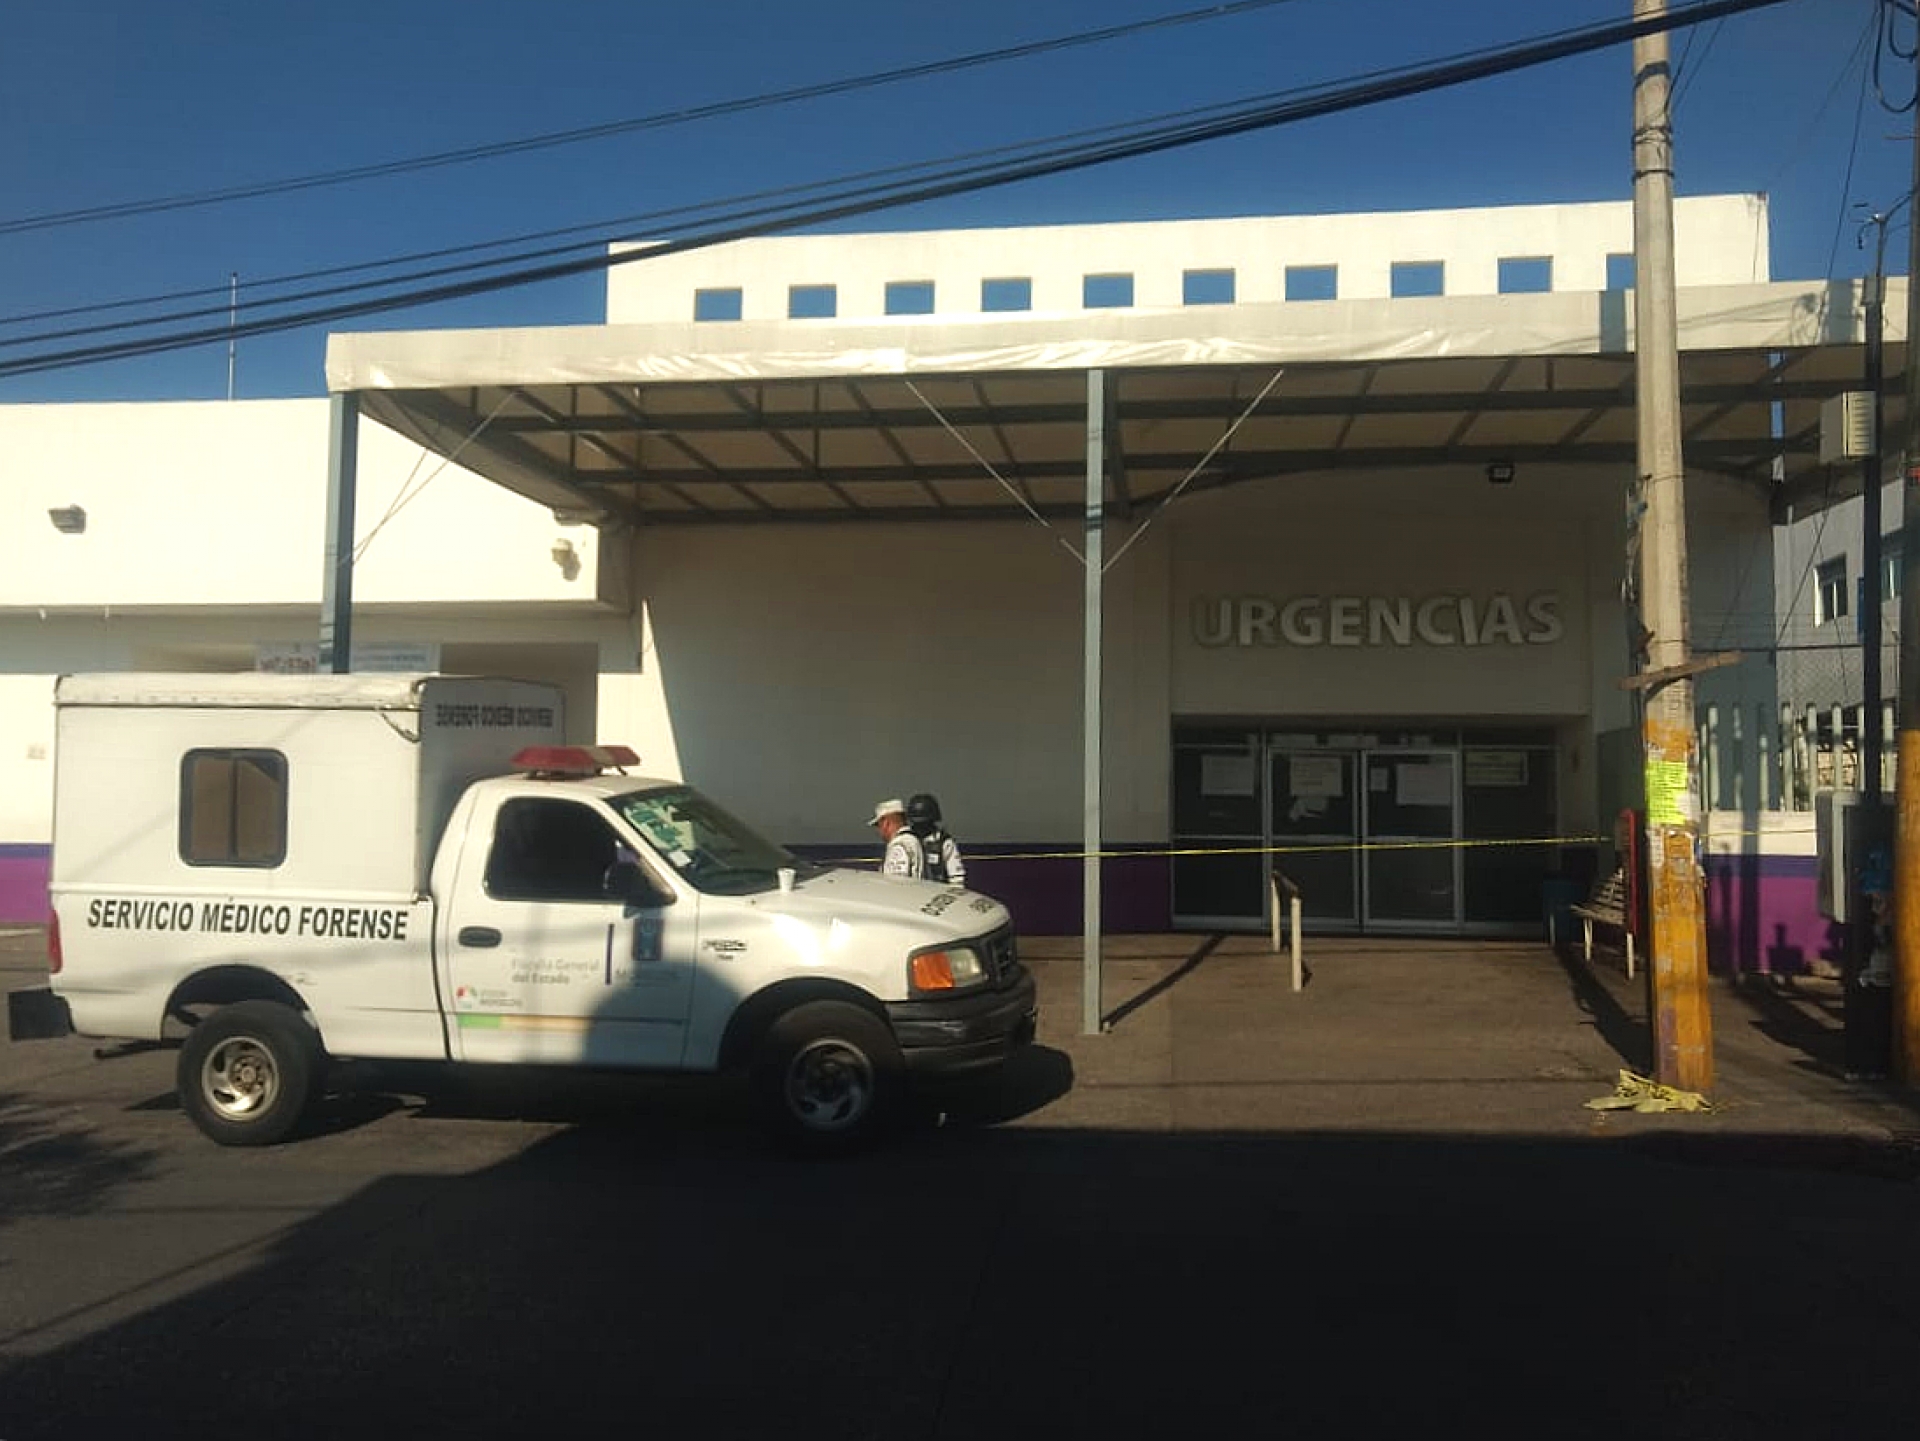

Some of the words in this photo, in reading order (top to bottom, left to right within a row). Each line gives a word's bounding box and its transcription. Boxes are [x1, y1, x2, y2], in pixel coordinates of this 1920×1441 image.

[1195, 595, 1564, 646] URGENCIAS
[87, 898, 194, 931] SERVICIO
[200, 896, 290, 935] MÉDICO
[298, 906, 408, 940] FORENSE
[511, 972, 530, 983] del
[532, 972, 570, 984] Estado
